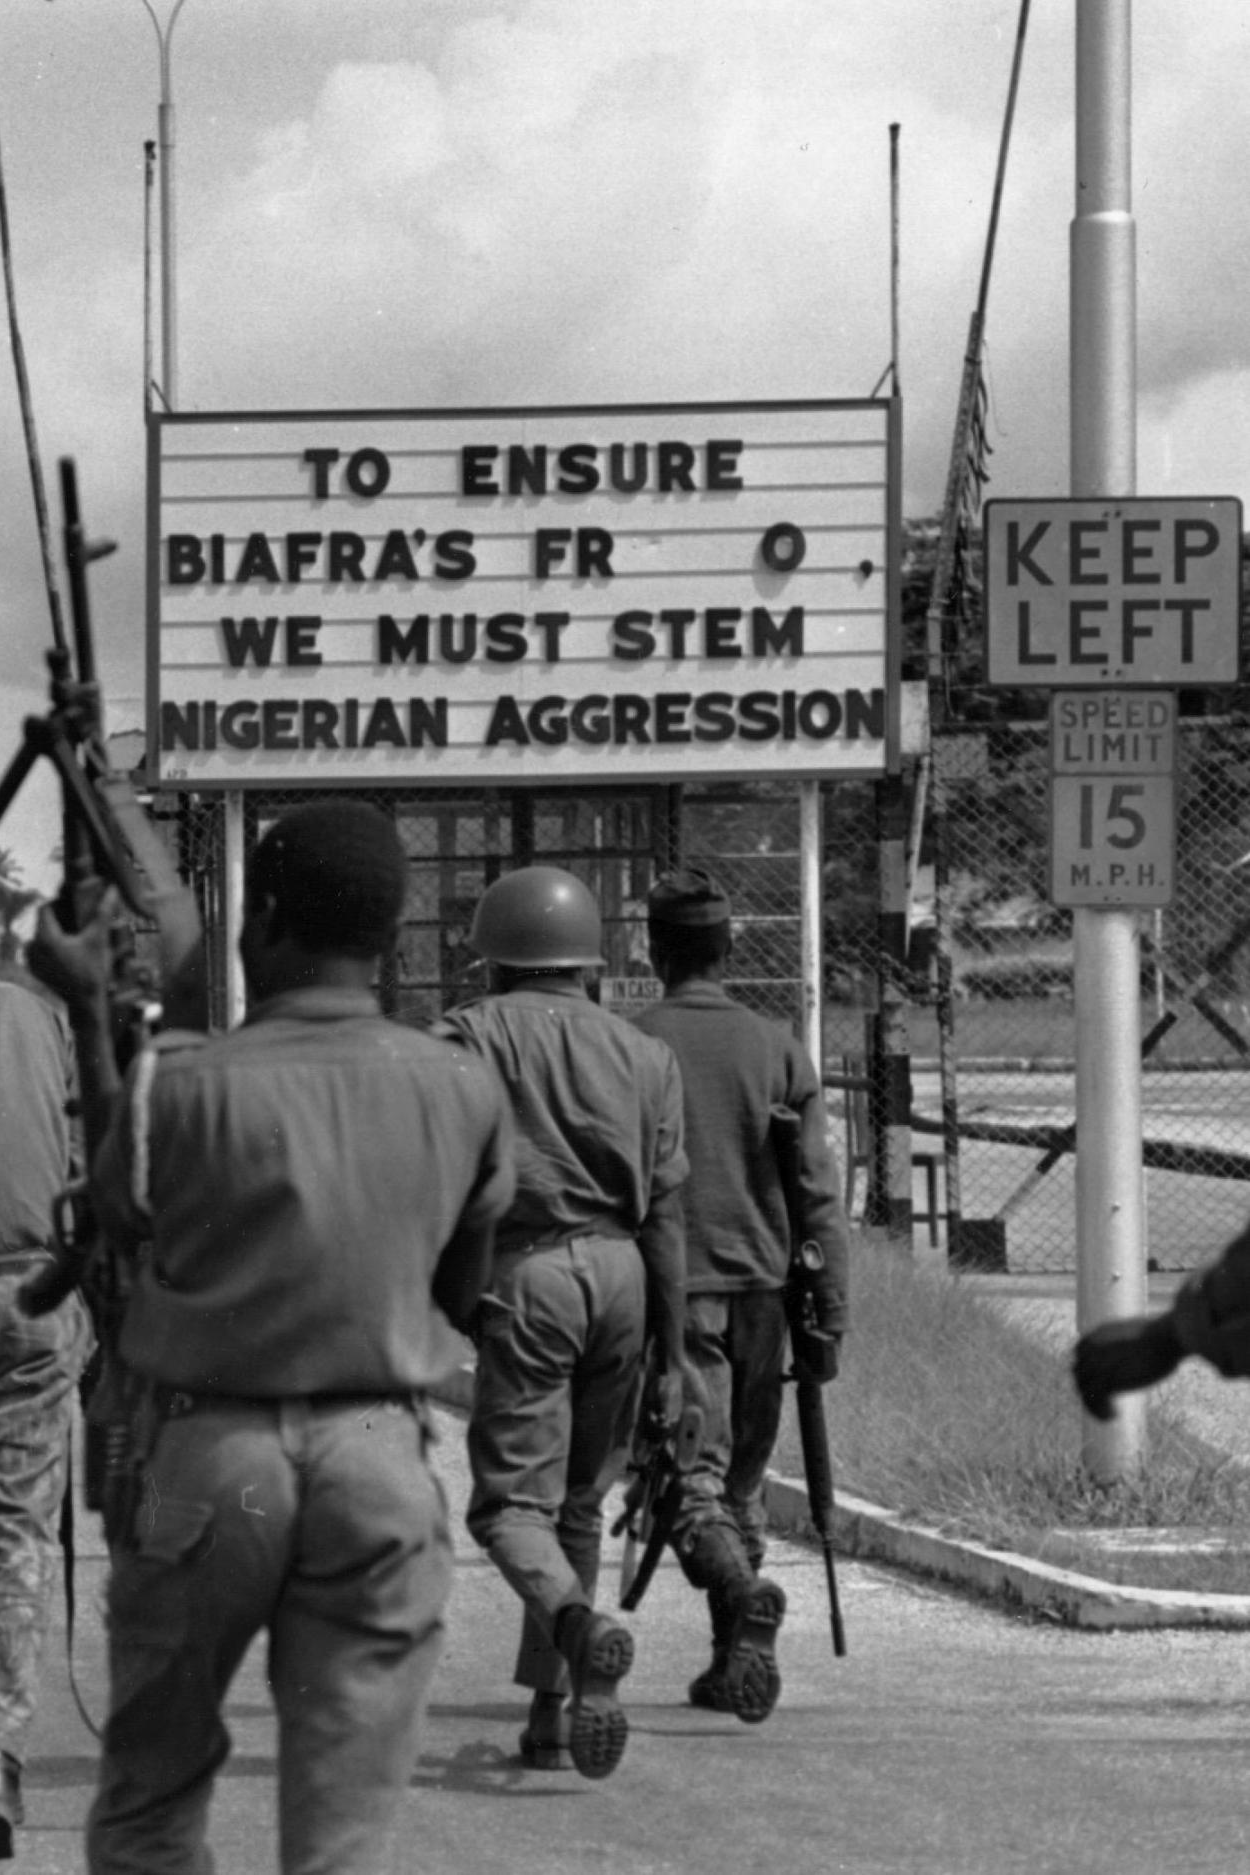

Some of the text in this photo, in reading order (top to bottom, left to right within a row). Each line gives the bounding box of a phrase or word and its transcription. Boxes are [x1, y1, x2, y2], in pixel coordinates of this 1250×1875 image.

[304, 441, 742, 499] TO ENSURE
[168, 530, 475, 585] BIAFRA'S
[536, 528, 613, 579] FR
[1007, 519, 1220, 586] KEEP
[221, 607, 804, 667] WE MUST STEM
[1018, 599, 1211, 665] LEFT
[161, 689, 885, 751] NIGERIAN AGGRESSION
[1059, 699, 1169, 730] SPEED
[1063, 733, 1164, 763] LIMIT
[1079, 784, 1146, 850] 15
[1070, 863, 1166, 888] M.P.H.
[612, 980, 626, 998] IN
